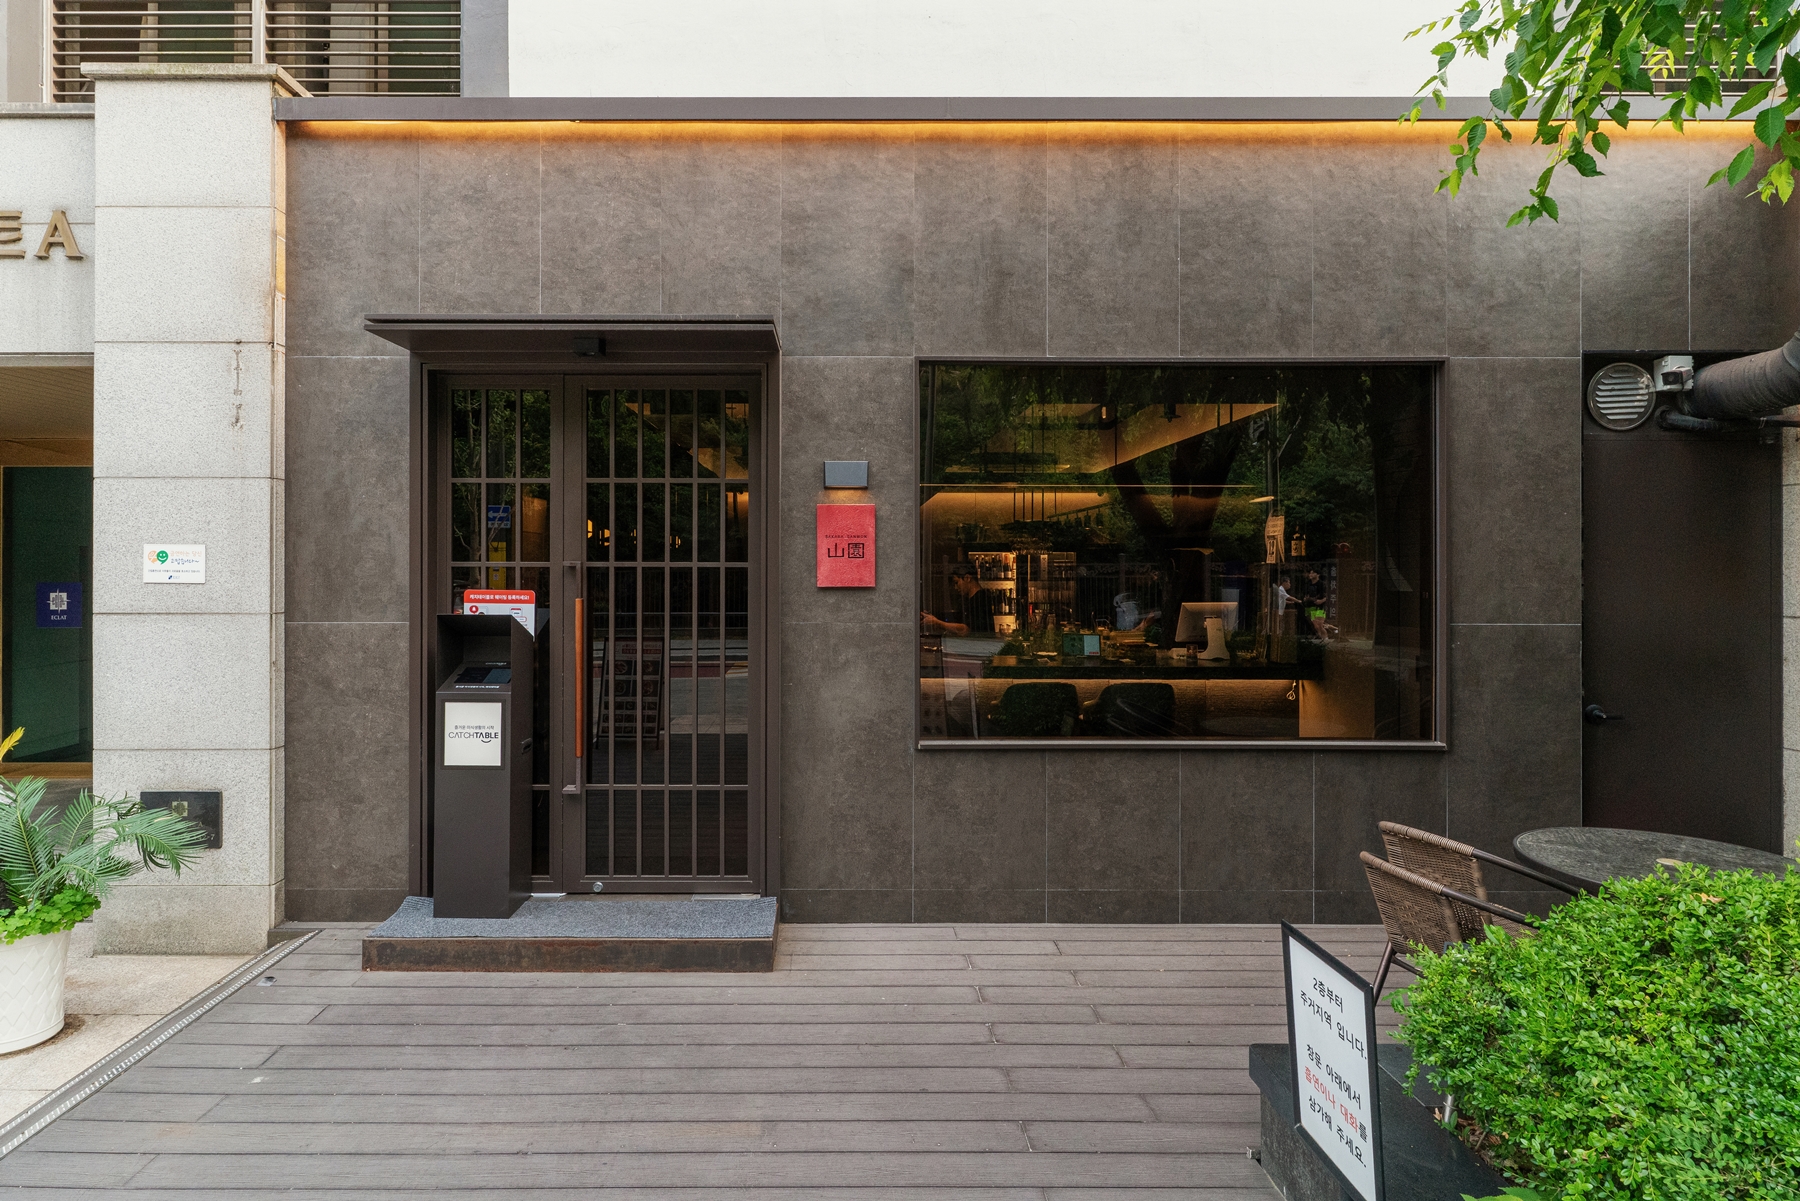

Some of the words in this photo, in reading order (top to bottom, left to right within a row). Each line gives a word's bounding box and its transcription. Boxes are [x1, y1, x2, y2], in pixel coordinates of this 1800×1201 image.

[448, 731, 499, 740] CATCHTABLE
[1299, 989, 1333, 1030] 주거지역
[1336, 1021, 1368, 1060] 입니다.
[1312, 977, 1344, 1014] 2층부터
[1304, 1065, 1336, 1111] 흡연이나
[1339, 1103, 1369, 1145] 대화를
[1306, 1043, 1323, 1070] 창문
[1325, 1063, 1362, 1111] 아래에서
[1308, 1094, 1333, 1132] 삼가해
[1336, 1124, 1367, 1169] 주세요.
